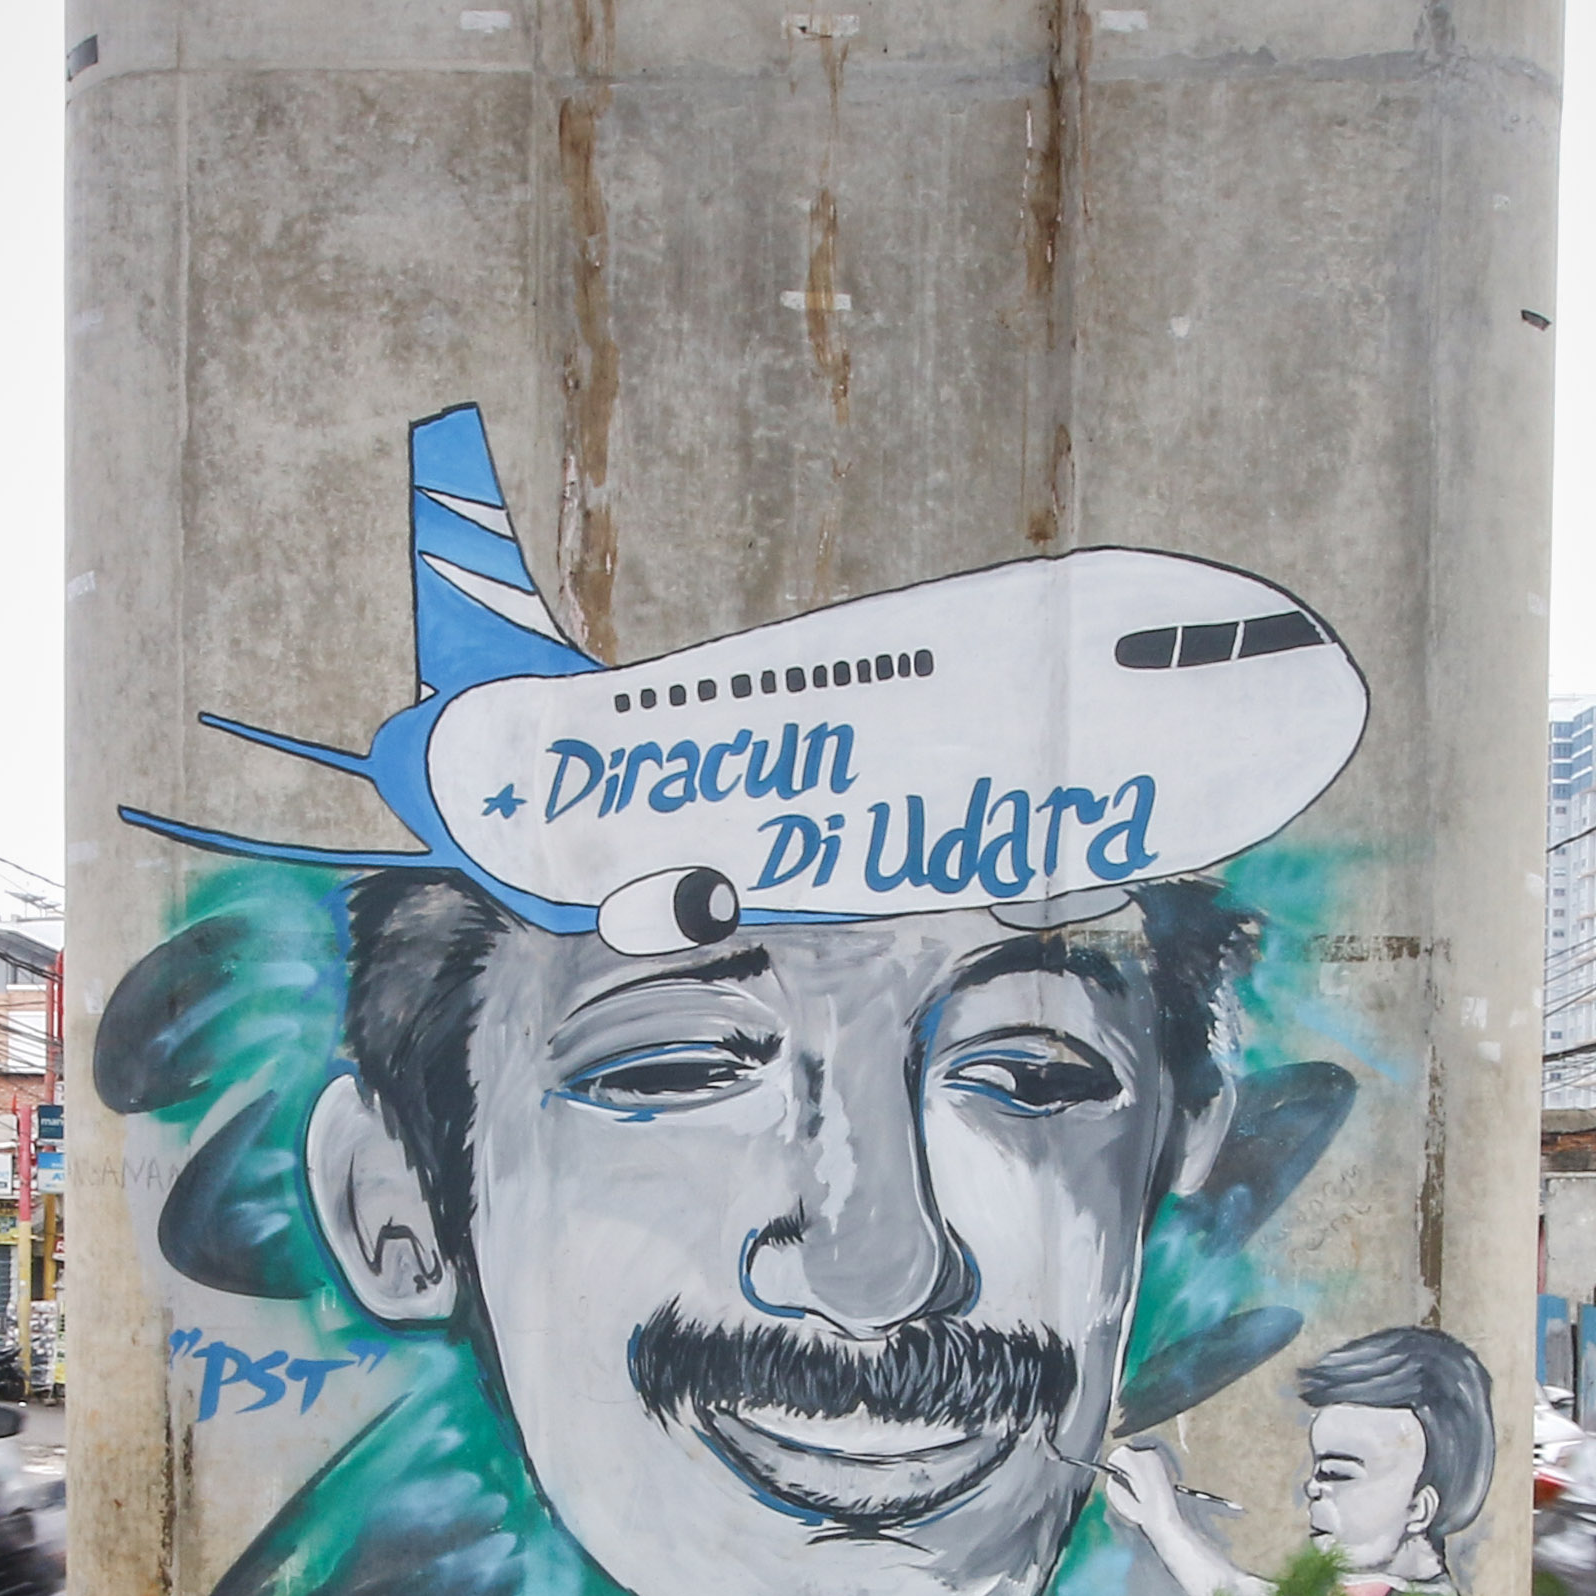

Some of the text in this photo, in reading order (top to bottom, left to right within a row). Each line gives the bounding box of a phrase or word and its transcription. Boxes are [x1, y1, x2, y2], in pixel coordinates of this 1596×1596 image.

[543, 721, 860, 823] Diracun
[746, 775, 1160, 898] Di Udara
